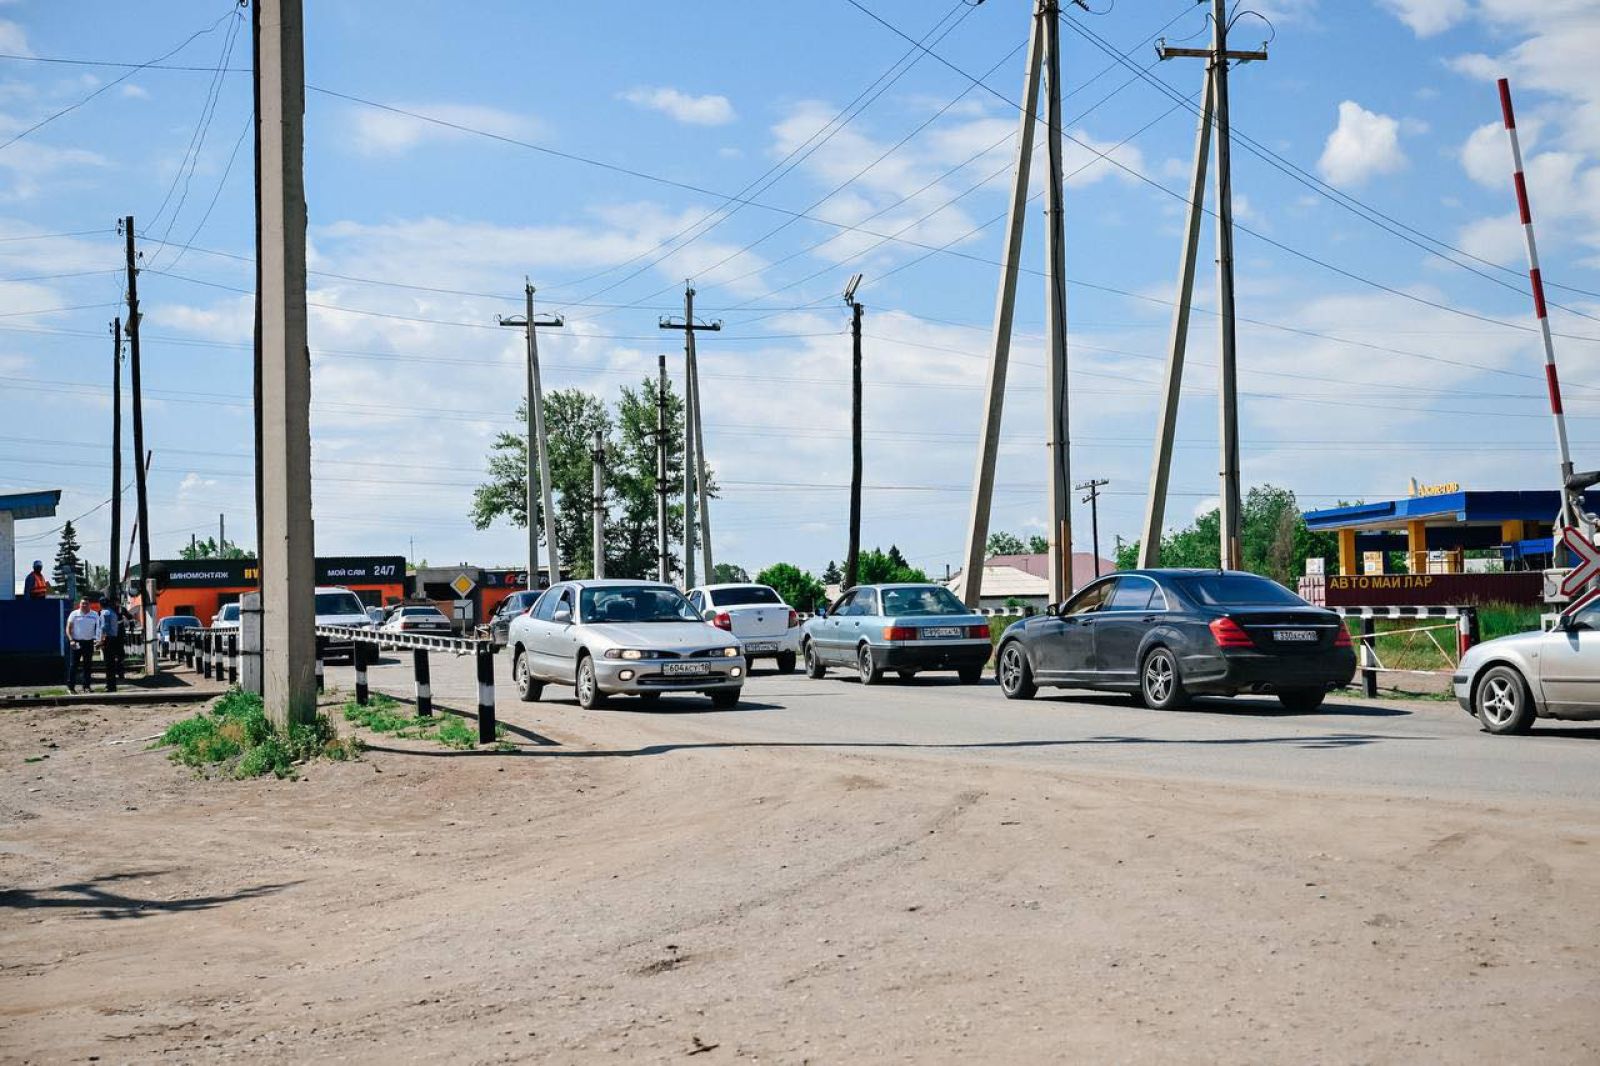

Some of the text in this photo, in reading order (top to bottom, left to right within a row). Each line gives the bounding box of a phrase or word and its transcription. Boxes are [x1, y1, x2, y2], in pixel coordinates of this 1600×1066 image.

[169, 571, 229, 580] ШИНОМОНТАЖ
[374, 565, 396, 576] 24/7
[1329, 577, 1370, 589] АВТО
